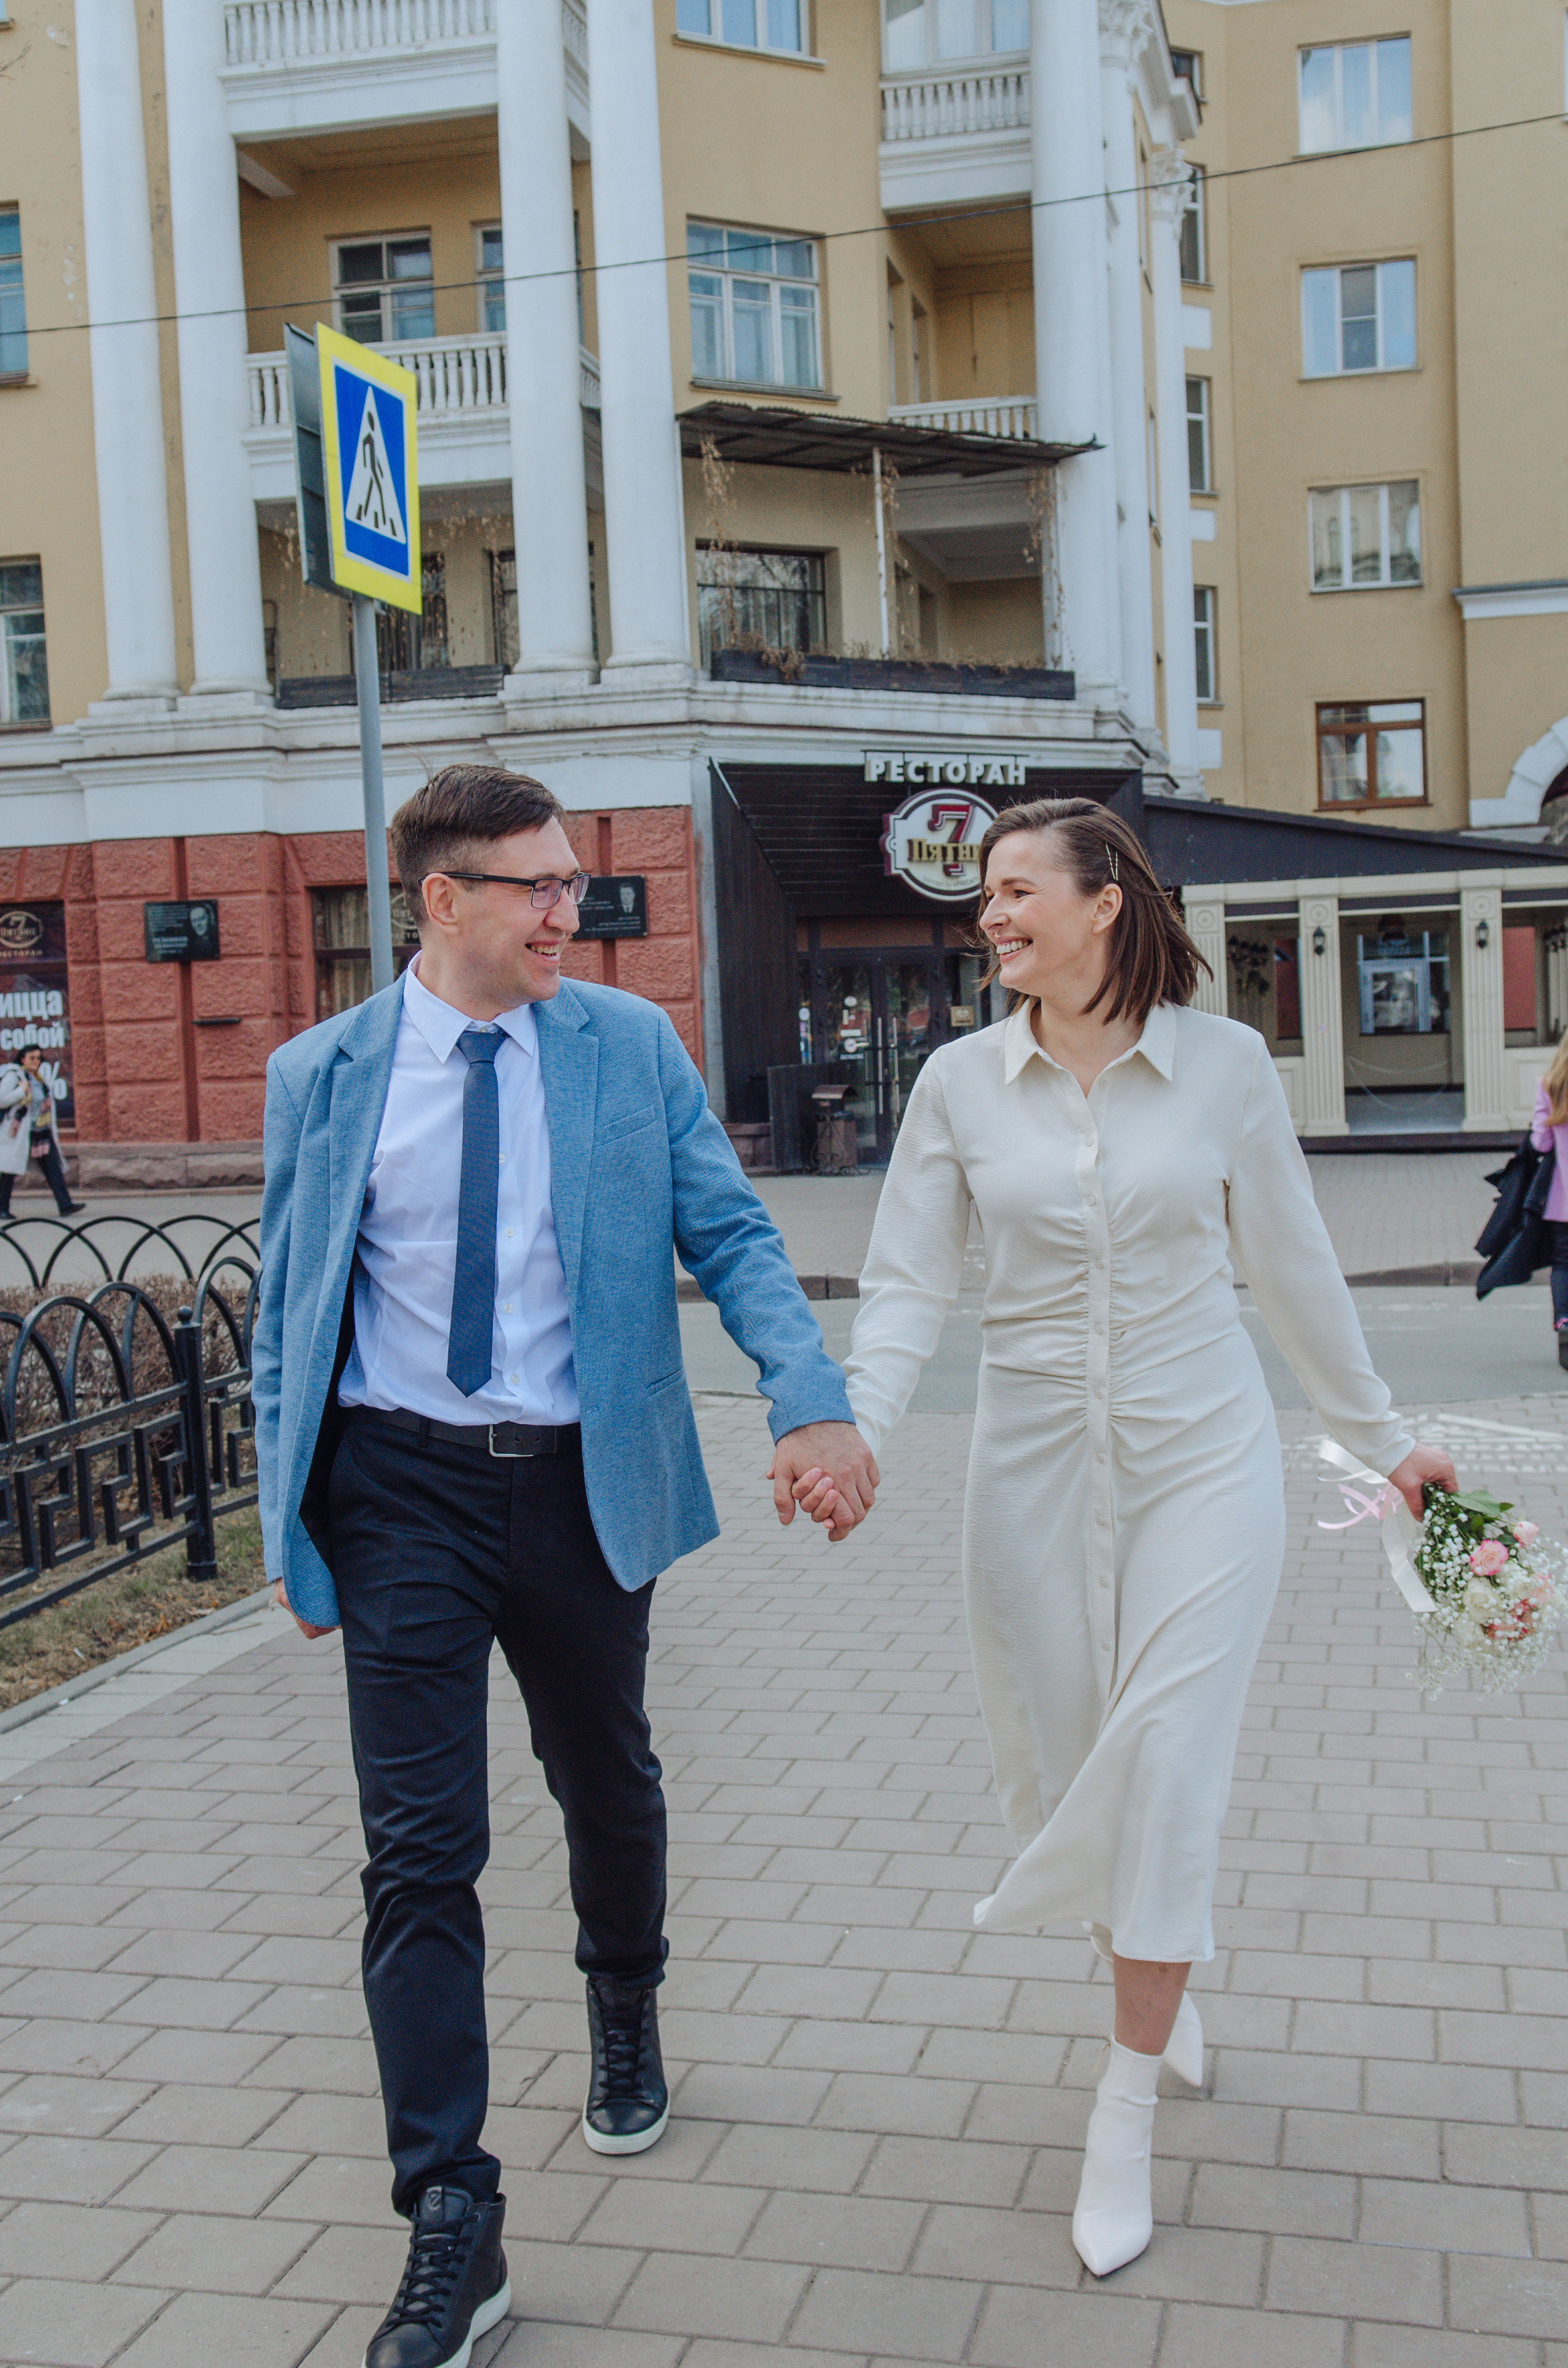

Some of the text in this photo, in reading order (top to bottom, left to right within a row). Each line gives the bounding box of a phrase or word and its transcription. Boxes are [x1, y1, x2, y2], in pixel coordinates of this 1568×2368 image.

[865, 759, 1026, 785] РЕСТОРАН
[927, 804, 975, 876] 7
[0, 950, 43, 959] ЕСТОРАН
[0, 1021, 65, 1051] собой
